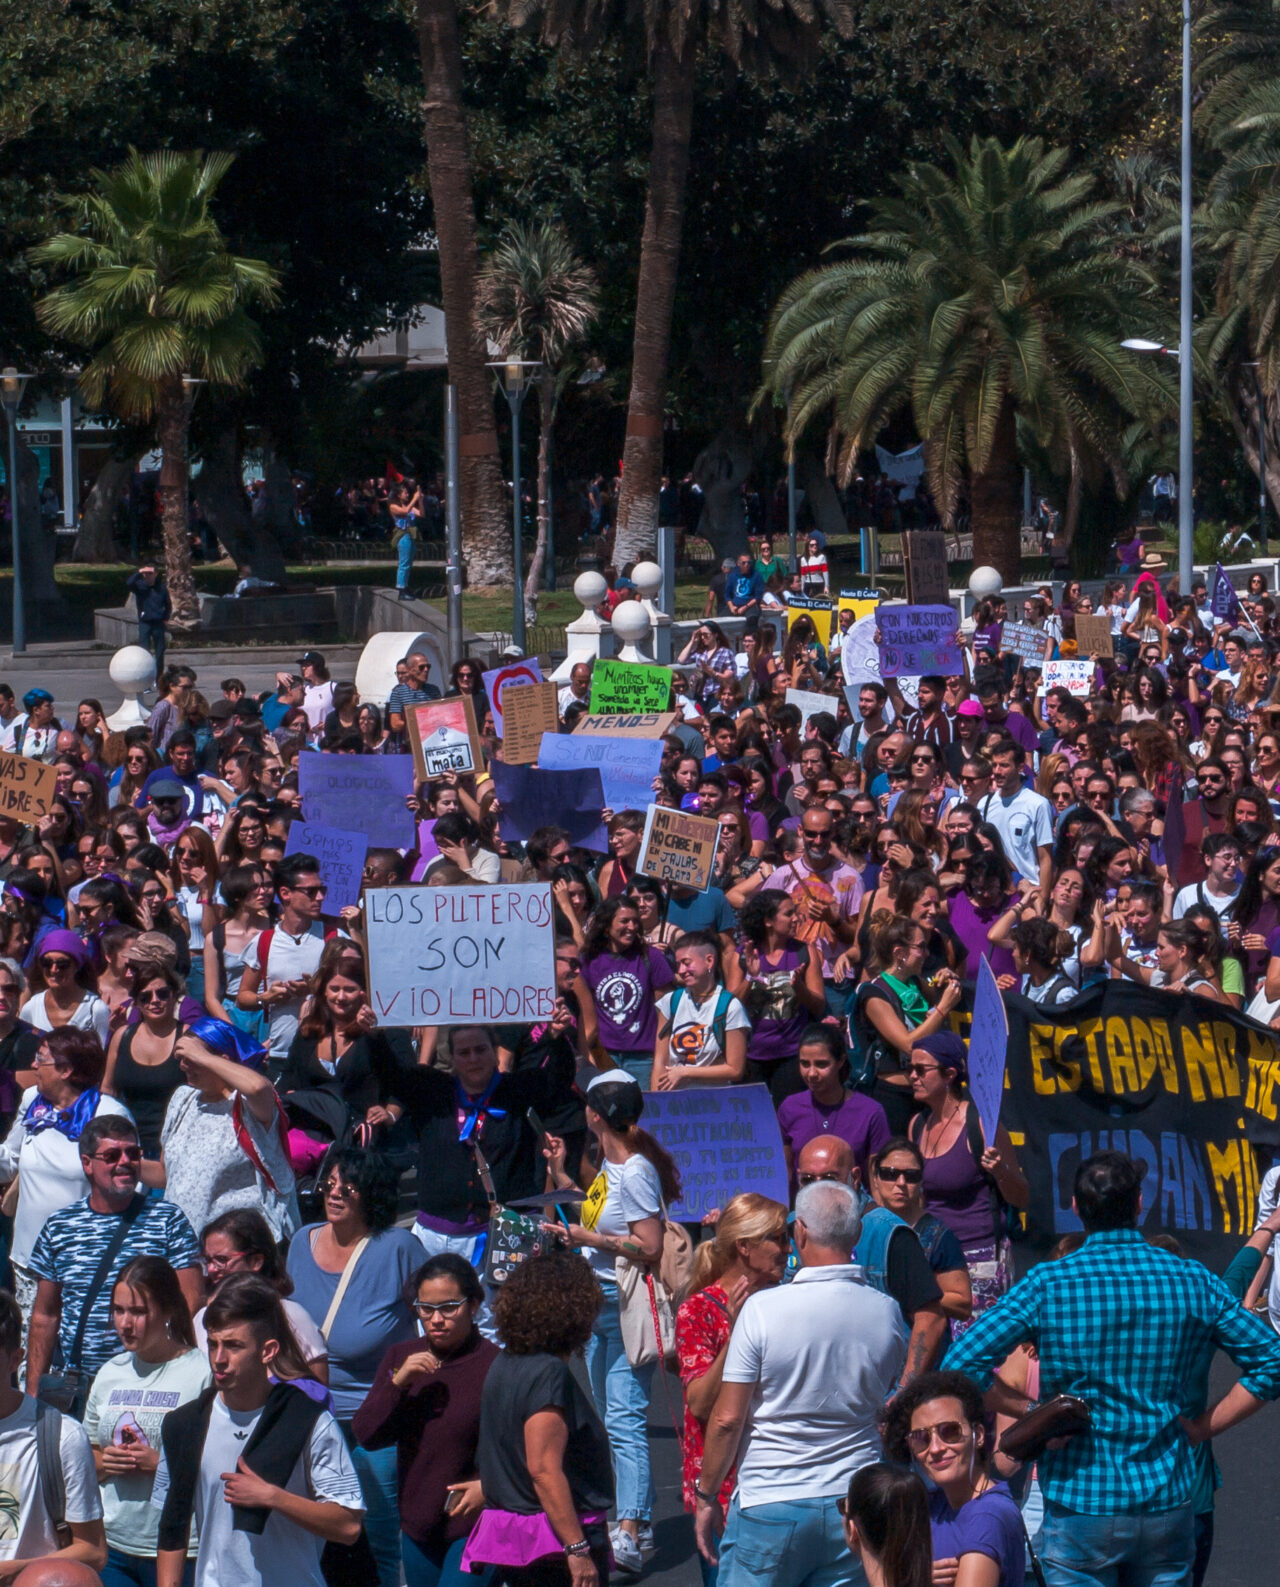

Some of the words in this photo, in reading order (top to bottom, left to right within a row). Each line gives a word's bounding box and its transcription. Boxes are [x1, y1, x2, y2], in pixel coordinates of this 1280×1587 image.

[880, 613, 900, 628] CON
[907, 612, 953, 627] NUESTROS
[885, 650, 898, 669] NO
[903, 652, 916, 669] SE
[1046, 663, 1057, 673] NO
[582, 714, 661, 730] MENOS
[432, 754, 465, 773] mata
[34, 768, 45, 787] Y
[0, 784, 46, 817] iBRES
[656, 813, 670, 830] MI
[302, 827, 353, 852] SOMOS
[651, 829, 664, 847] NO
[664, 834, 692, 852] CABE
[660, 851, 698, 870] JAULAS
[646, 860, 657, 871] DE
[662, 864, 691, 882] PLATA
[372, 893, 423, 924] LOS
[434, 891, 551, 928] PUTEROS
[418, 936, 506, 970] SON
[1029, 1016, 1179, 1095] ESTADO
[1181, 1021, 1241, 1103] NO
[668, 1098, 720, 1117] QUIERO
[721, 1147, 775, 1163] RESPETO
[723, 1167, 739, 1182] EN
[745, 1166, 776, 1180] ESTA
[1049, 1130, 1213, 1234] CDAN
[143, 1390, 181, 1408] CRUSH
